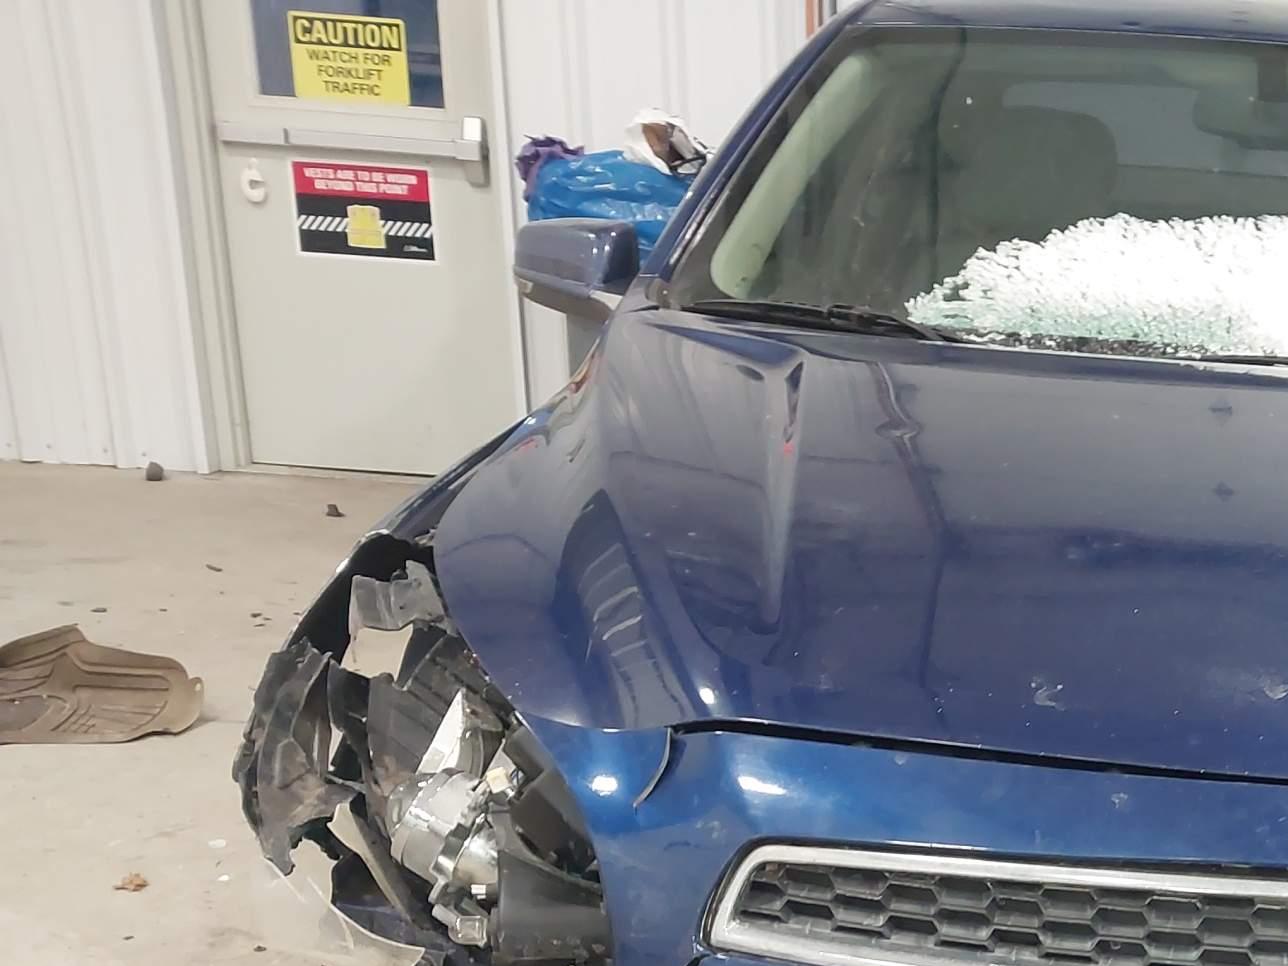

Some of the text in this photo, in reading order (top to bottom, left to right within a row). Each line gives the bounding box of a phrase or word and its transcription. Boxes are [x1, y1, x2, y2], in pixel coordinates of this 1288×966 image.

[295, 18, 400, 49] CAUTION
[306, 48, 392, 67] WATCH FOR
[317, 65, 384, 81] FORKLIFT
[322, 80, 381, 97] TRAFFIC
